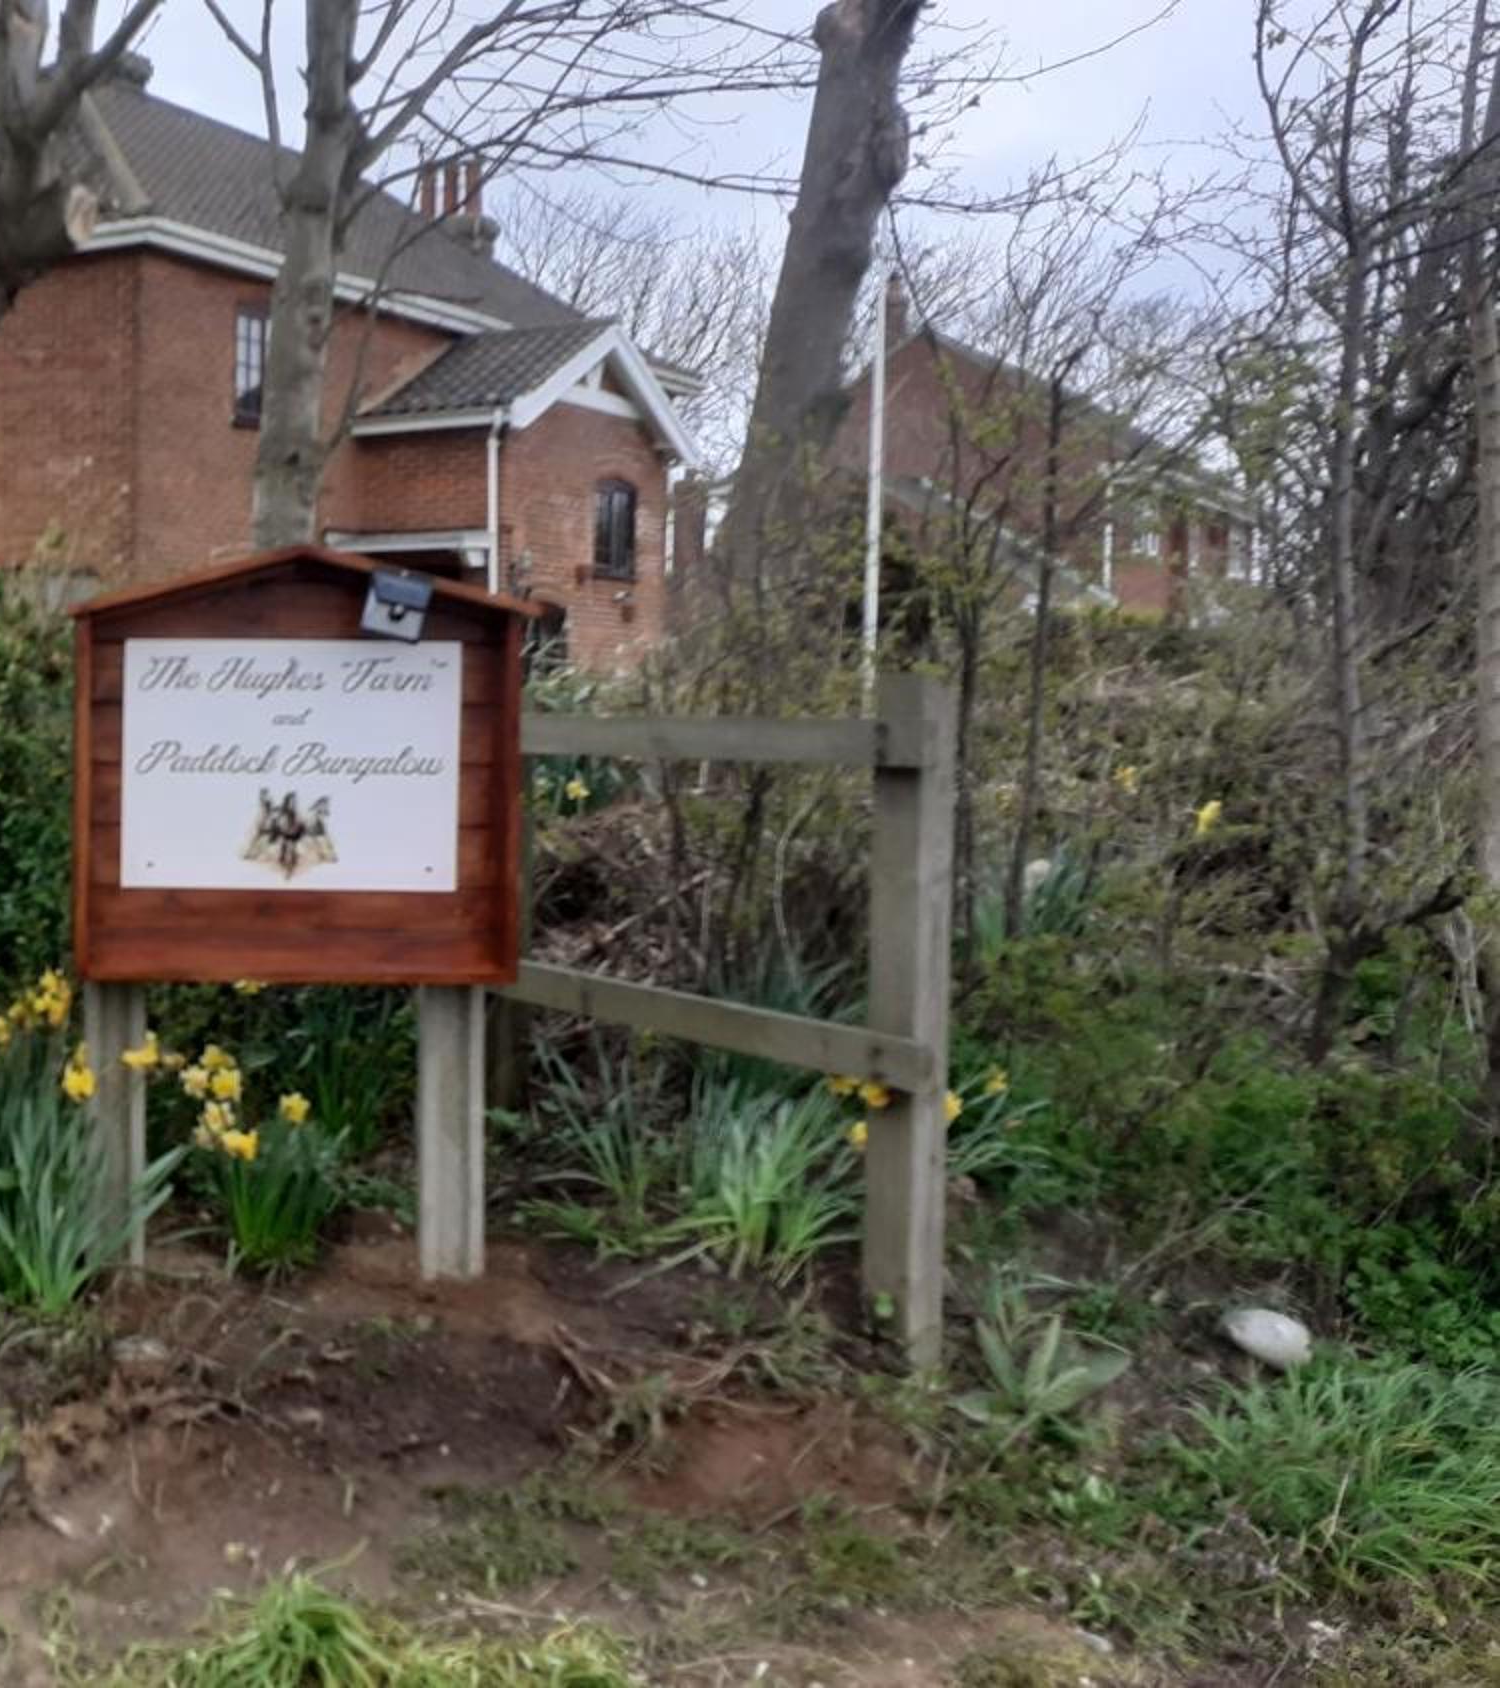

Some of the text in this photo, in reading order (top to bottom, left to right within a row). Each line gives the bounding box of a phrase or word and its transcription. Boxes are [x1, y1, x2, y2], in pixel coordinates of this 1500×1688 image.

[138, 656, 198, 691] The
[206, 656, 325, 699] Hughes
[271, 707, 312, 726] and
[134, 740, 443, 784] Paddock Bungalow
